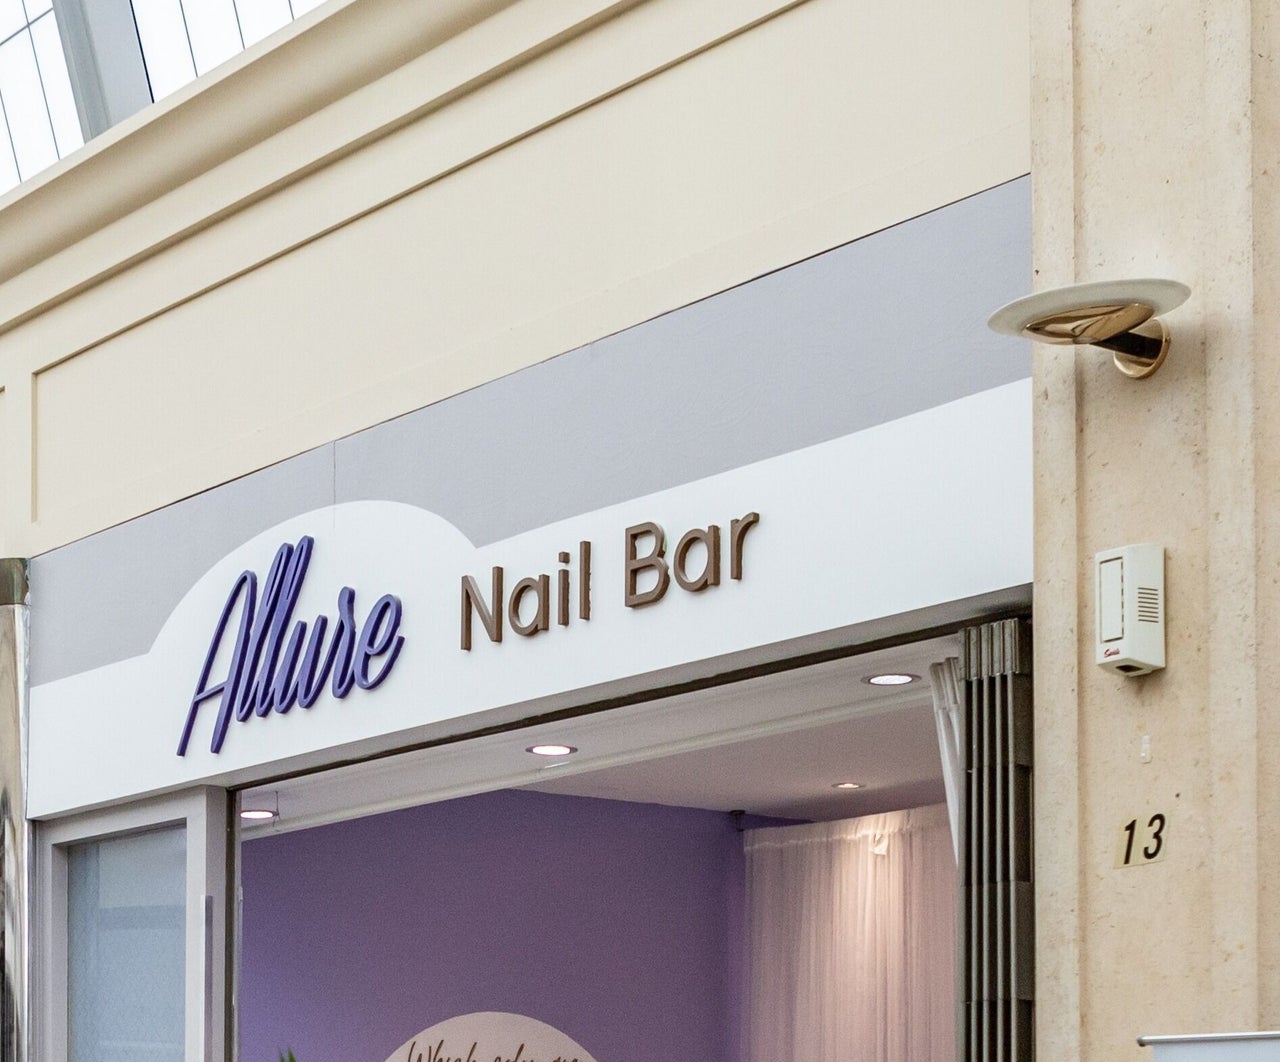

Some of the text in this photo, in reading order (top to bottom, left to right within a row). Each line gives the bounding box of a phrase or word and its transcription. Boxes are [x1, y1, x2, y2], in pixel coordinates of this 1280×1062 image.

[177, 512, 759, 757] Allure Nail Bar
[1123, 813, 1166, 864] 13
